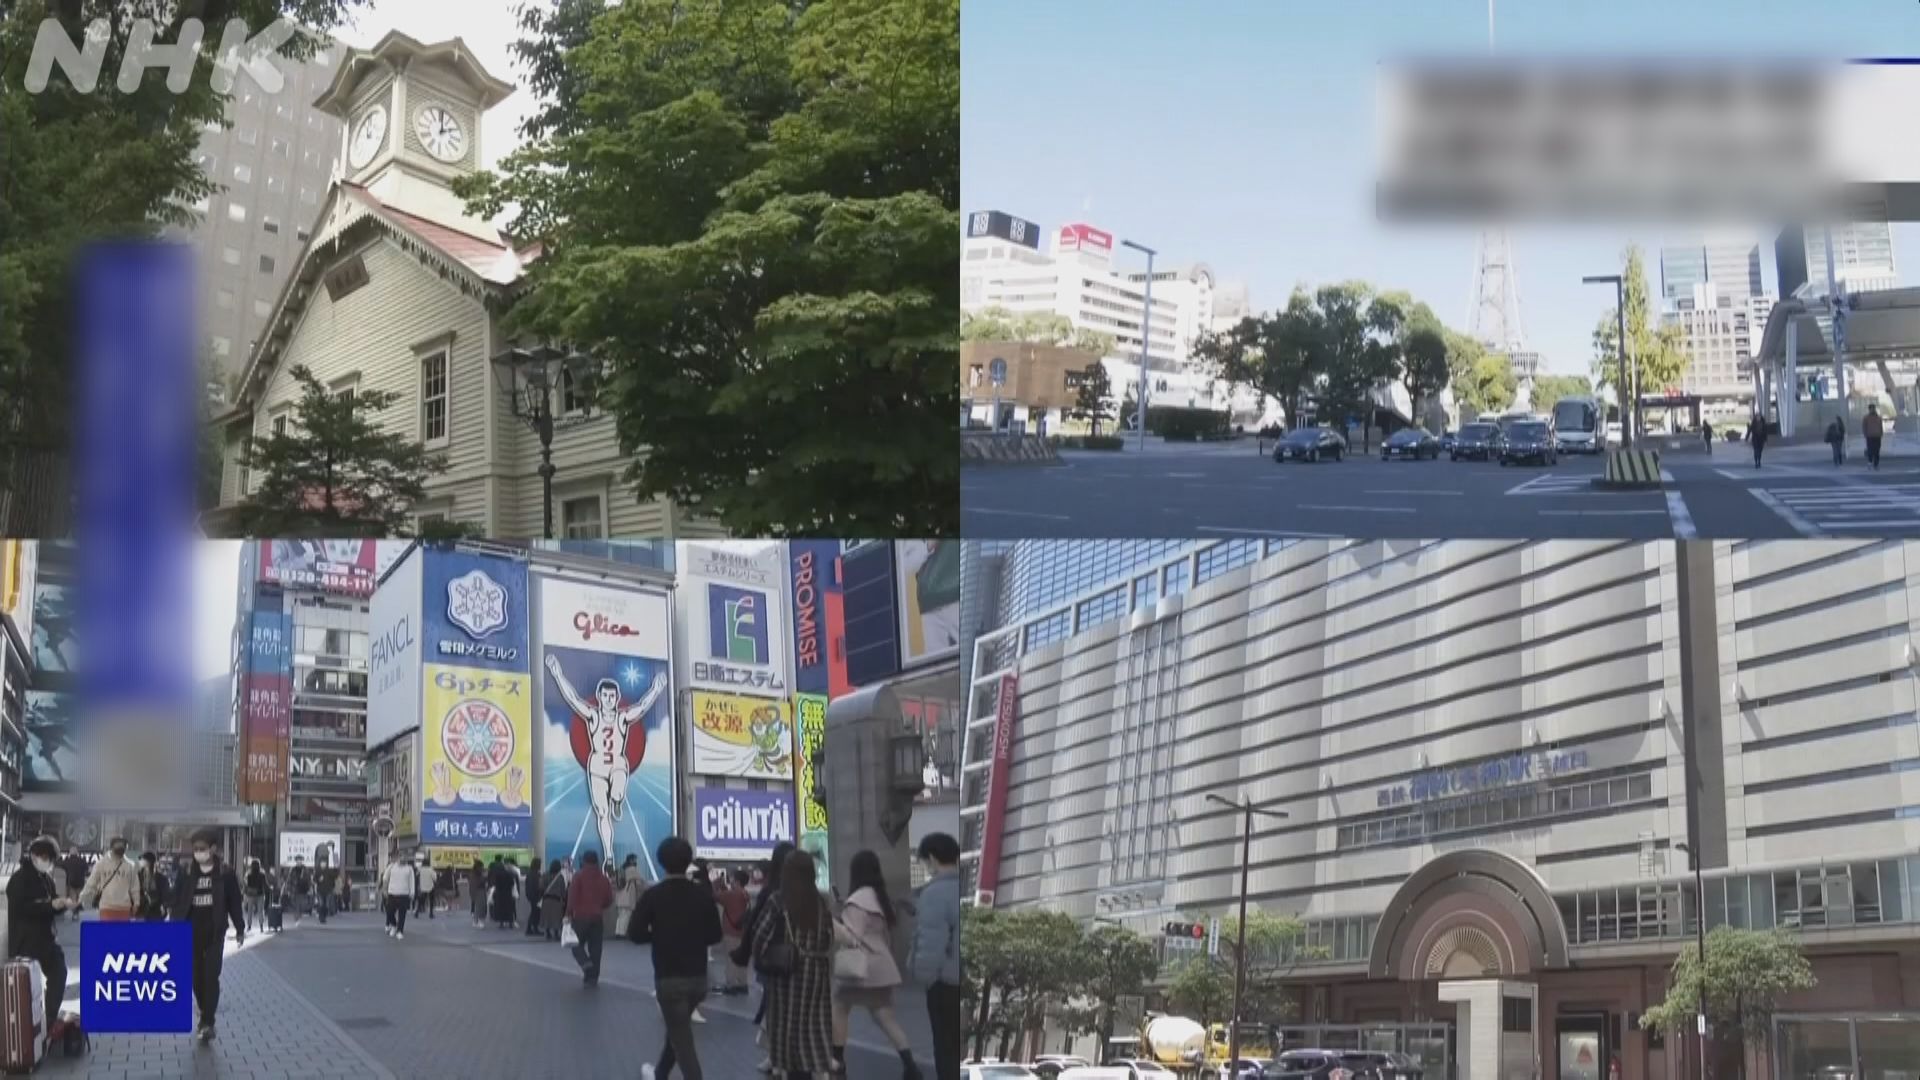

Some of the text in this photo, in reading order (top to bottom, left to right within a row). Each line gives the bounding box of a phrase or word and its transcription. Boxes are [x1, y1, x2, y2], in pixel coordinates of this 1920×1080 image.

[794, 550, 818, 668] PROMISE
[573, 611, 640, 641] Glico
[371, 613, 414, 675] FANCL
[695, 662, 784, 688] 日商エステム
[702, 713, 743, 733] 改源
[290, 756, 320, 774] NY
